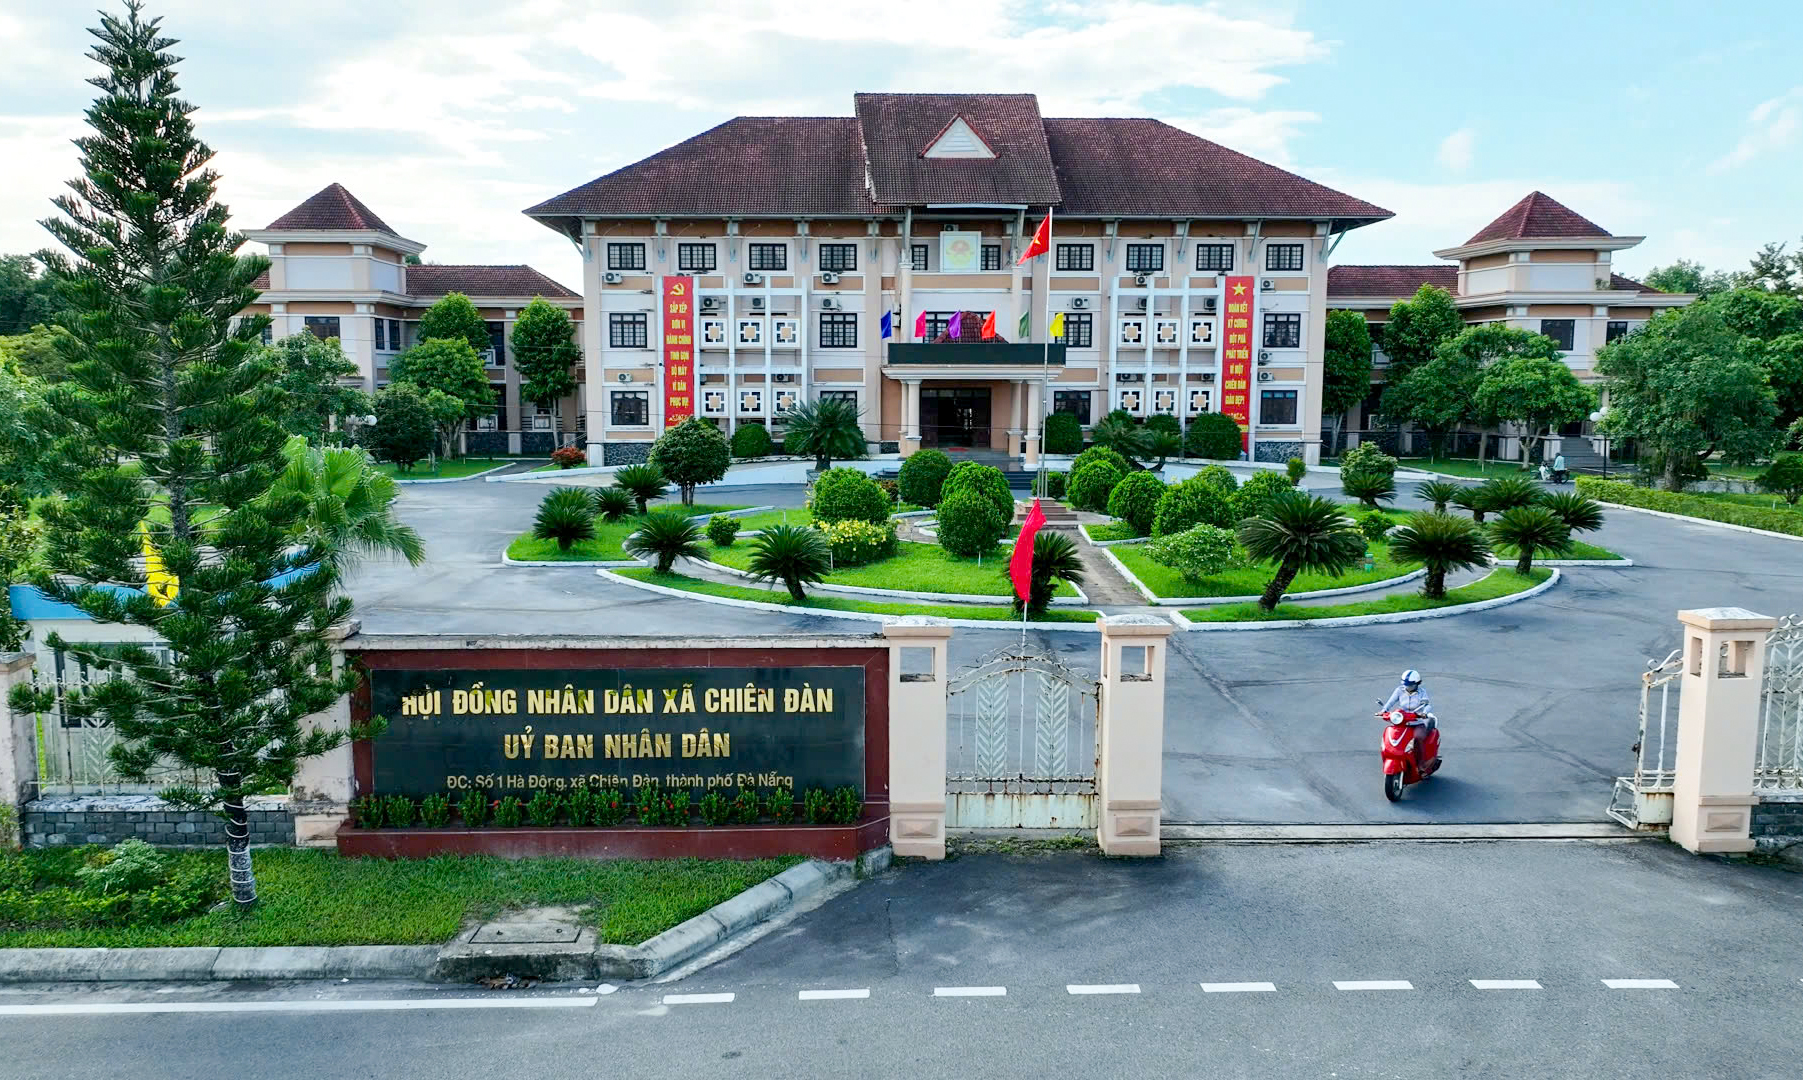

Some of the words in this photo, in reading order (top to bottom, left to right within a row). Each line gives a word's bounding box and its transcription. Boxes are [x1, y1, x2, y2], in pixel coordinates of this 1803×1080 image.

[452, 682, 518, 715] ĐỒNG
[527, 684, 595, 714] NHÂN
[604, 683, 654, 714] DÂN
[662, 683, 696, 714] XÃ
[704, 683, 775, 713] CHIÊN
[783, 682, 834, 713] ĐÀN
[504, 725, 535, 759] UỶ
[544, 734, 594, 759] BAN
[604, 728, 672, 759] NHÂN
[681, 728, 731, 758] DÂN
[447, 775, 472, 789] ĐC:
[475, 773, 494, 789] Số
[497, 775, 503, 788] 1
[507, 774, 525, 788] Hà
[570, 774, 586, 788] xã
[589, 774, 629, 788] Chiên
[665, 773, 704, 787] thành
[708, 772, 734, 790] phố
[737, 773, 756, 787] Đà
[758, 771, 793, 789] Nẵng
